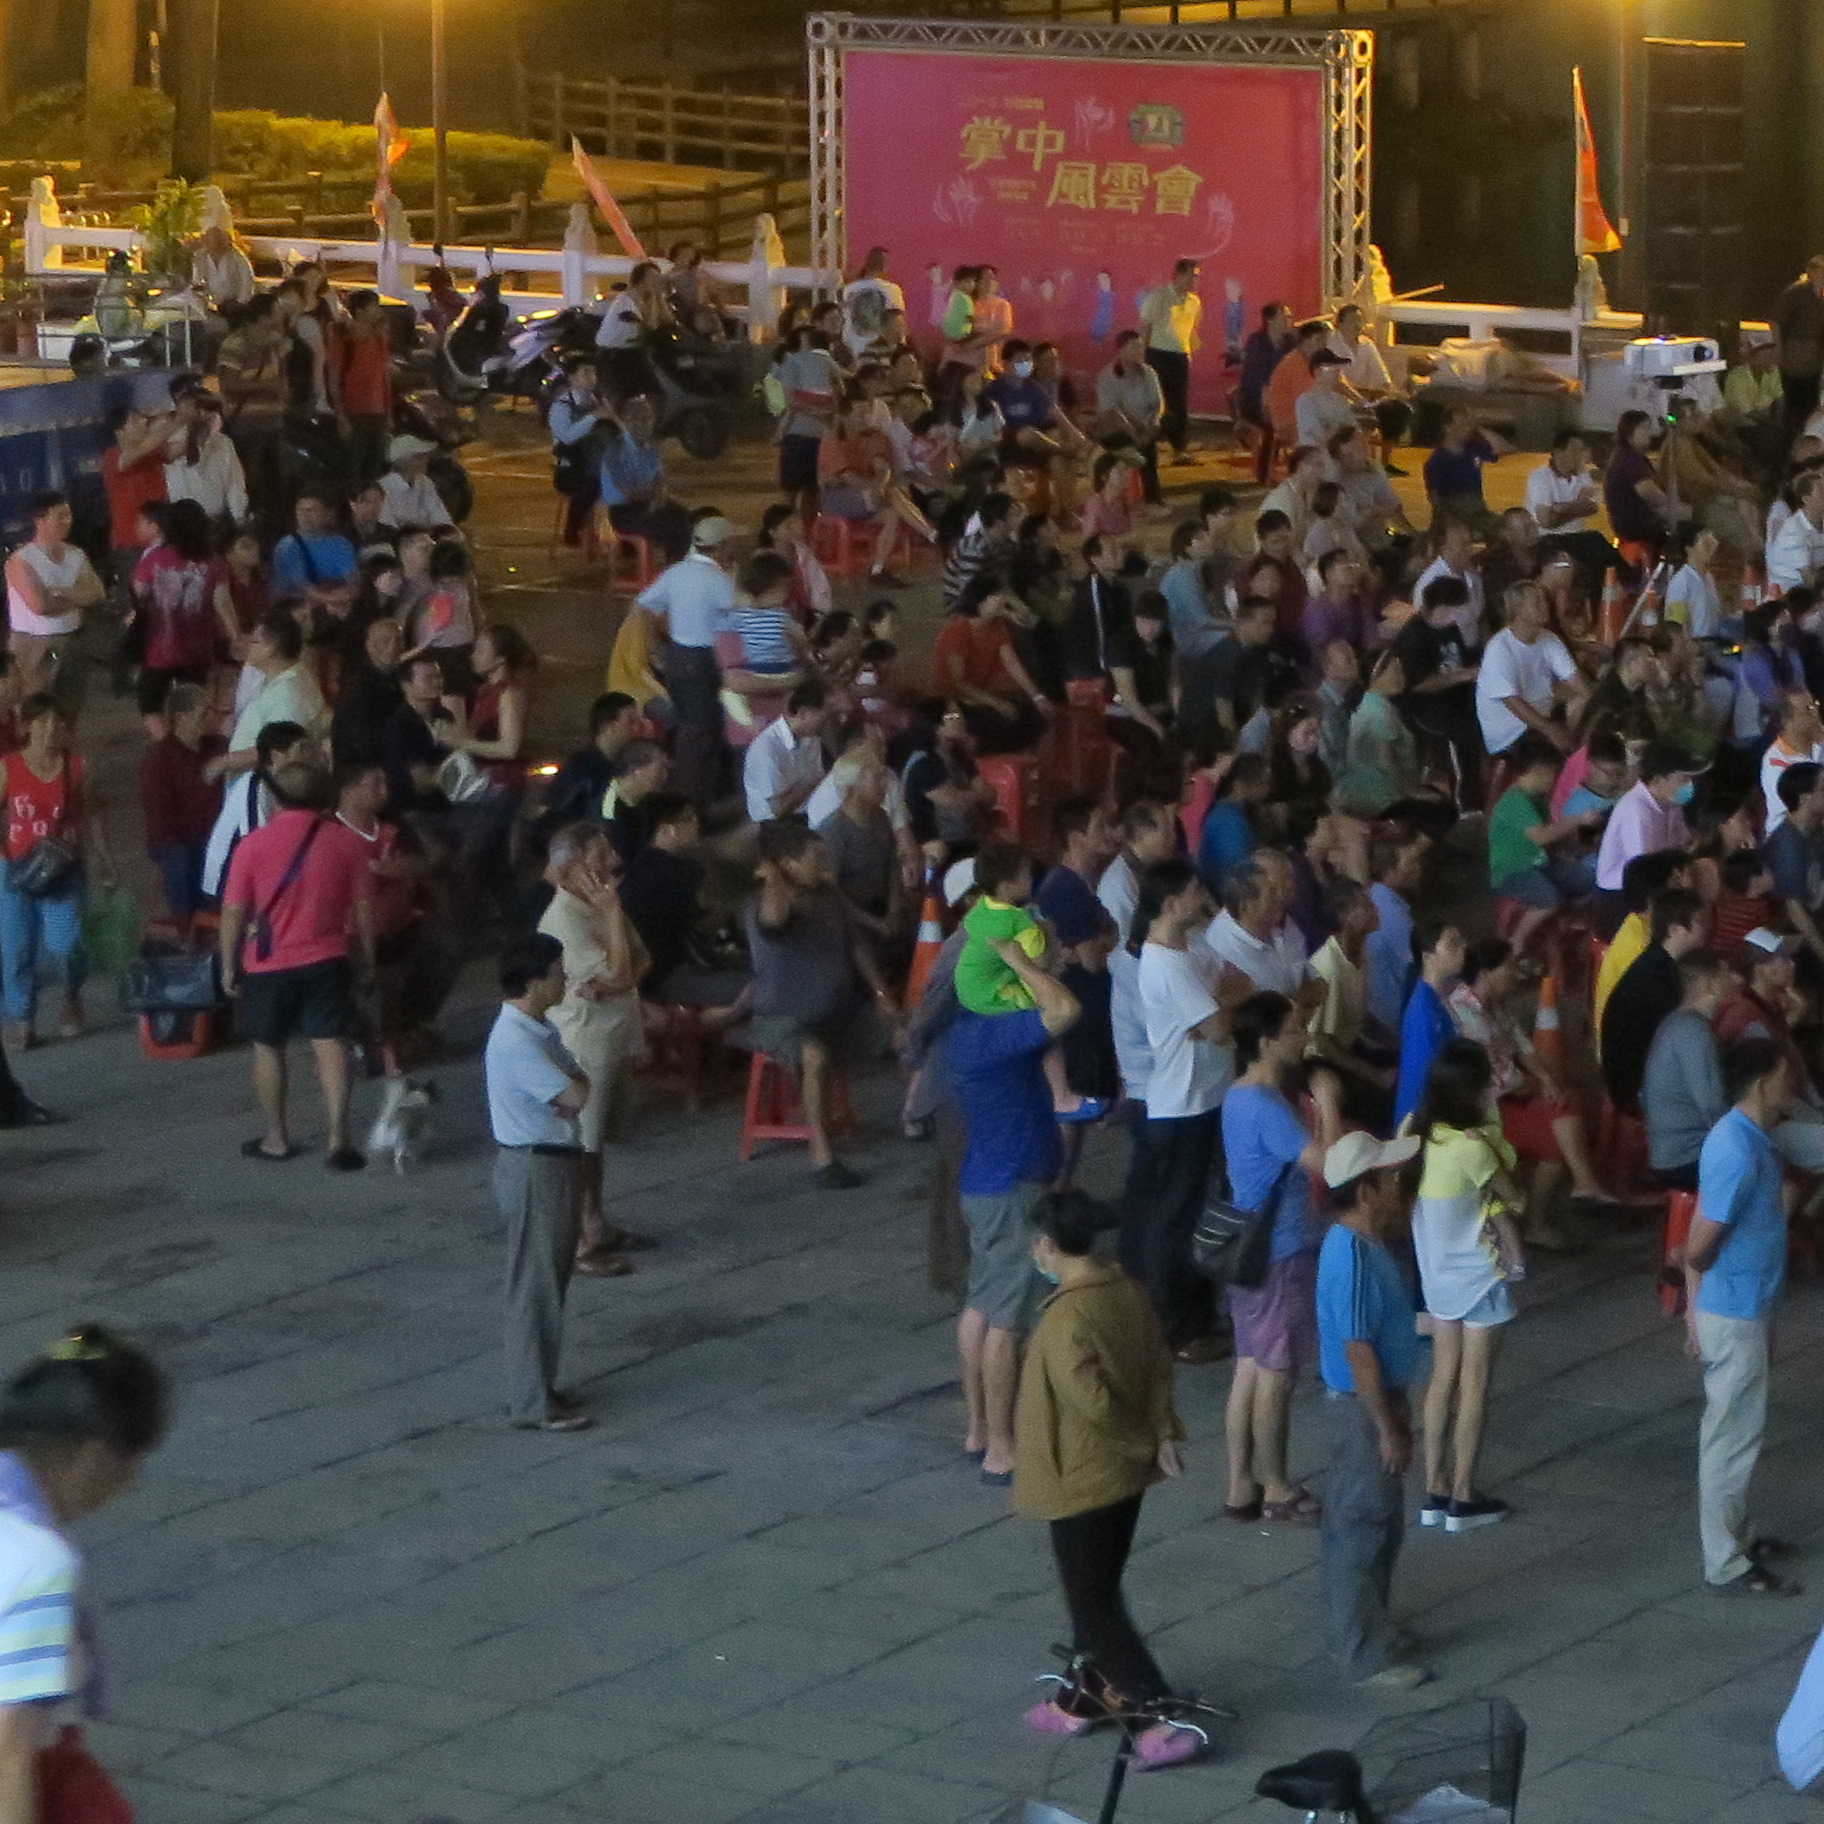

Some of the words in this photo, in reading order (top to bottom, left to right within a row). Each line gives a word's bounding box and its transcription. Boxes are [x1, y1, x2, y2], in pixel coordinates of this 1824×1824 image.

[959, 116, 1066, 173] 掌中
[1045, 160, 1205, 218] 風雲會
